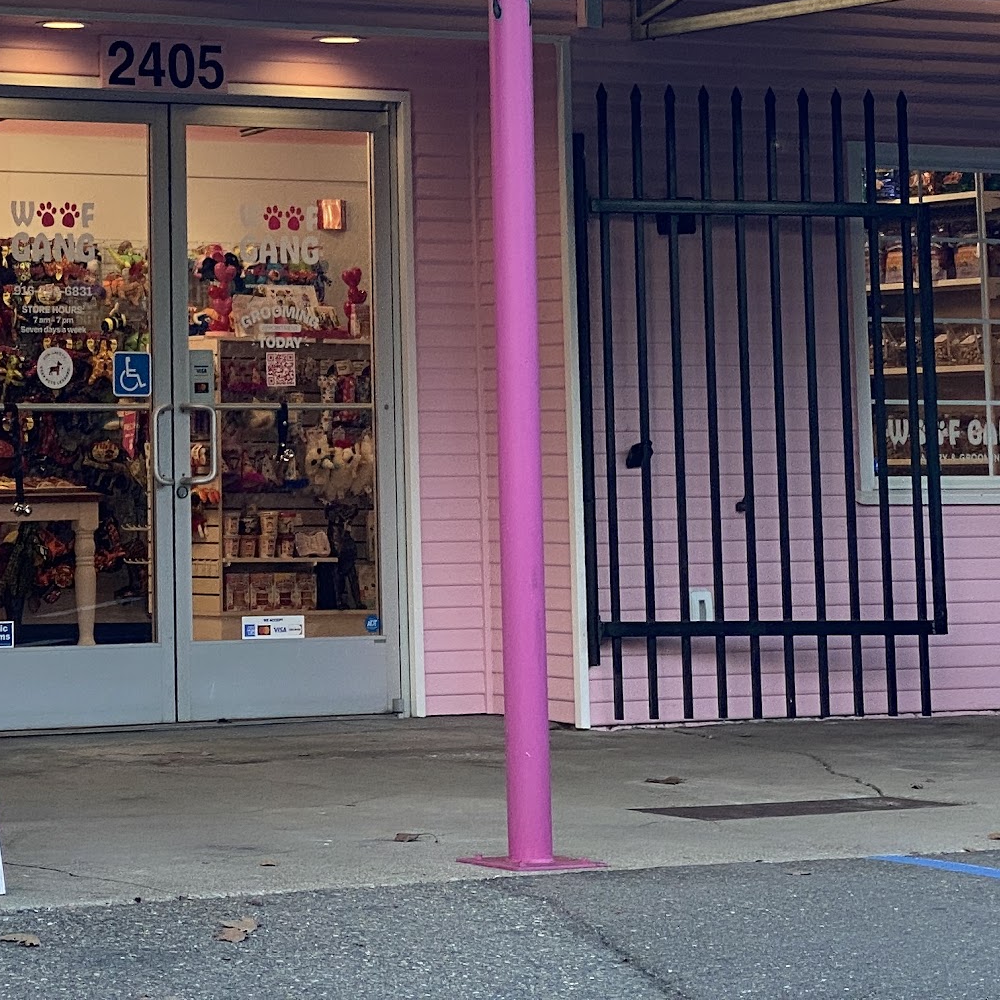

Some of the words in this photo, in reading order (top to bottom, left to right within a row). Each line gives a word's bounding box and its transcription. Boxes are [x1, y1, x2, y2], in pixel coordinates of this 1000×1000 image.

[108, 40, 224, 89] 2405
[10, 200, 95, 228] WF
[11, 231, 96, 262] GANG
[240, 235, 320, 265] GANG
[13, 285, 93, 297] 916--6831
[22, 305, 50, 314] STORE
[33, 316, 39, 324] 7
[56, 316, 61, 324] 7
[62, 317, 74, 327] pm
[241, 305, 320, 330] GROOMING
[21, 326, 43, 334] Seven
[67, 326, 87, 334] week
[260, 336, 303, 349] TODAY
[886, 419, 961, 446] WF
[967, 419, 1000, 446] GA
